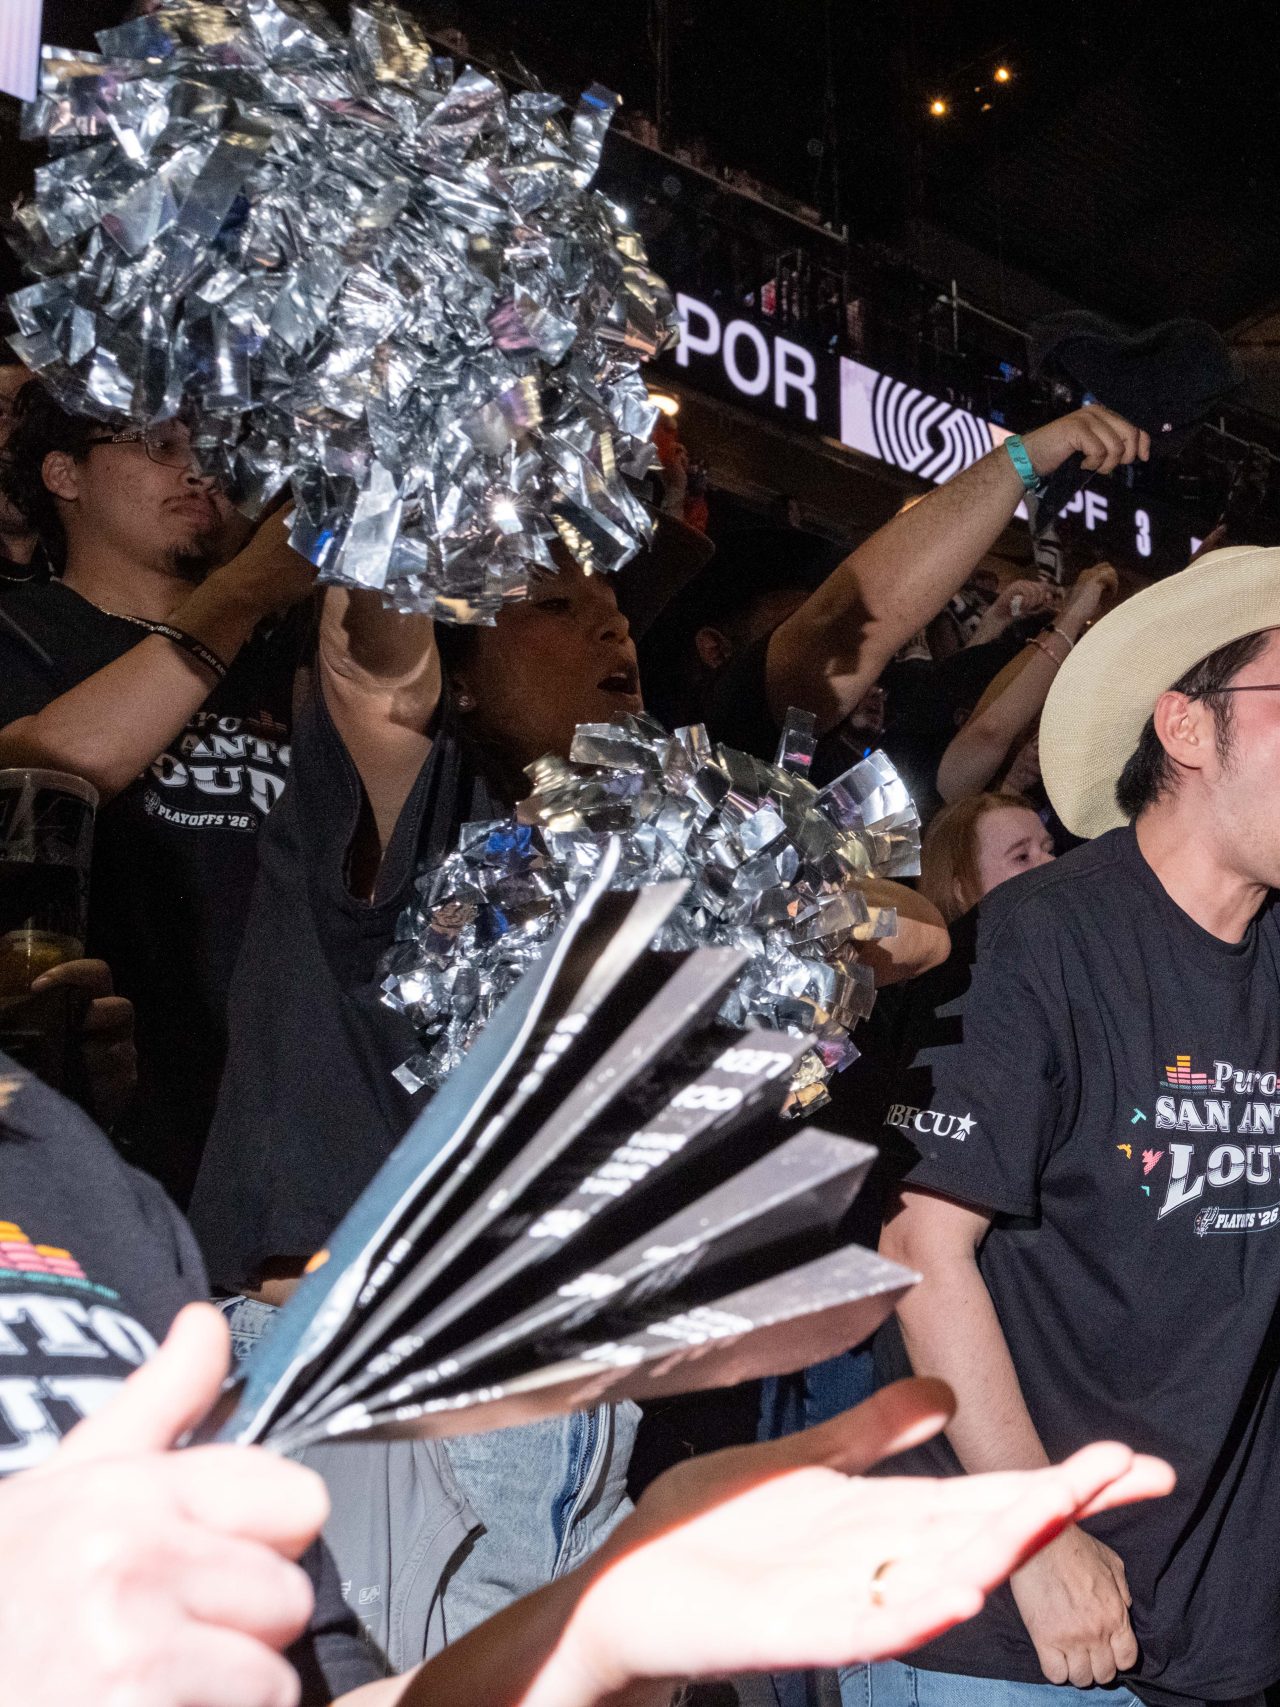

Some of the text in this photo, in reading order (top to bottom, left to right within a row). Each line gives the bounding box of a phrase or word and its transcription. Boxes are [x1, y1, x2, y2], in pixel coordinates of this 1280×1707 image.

[676, 292, 817, 421] POR
[1135, 509, 1151, 557] 3
[158, 803, 249, 829] PLAYOFFS '26
[1211, 1059, 1278, 1096] Puro
[882, 1103, 957, 1137] BFCU
[1155, 1095, 1231, 1133] SAN
